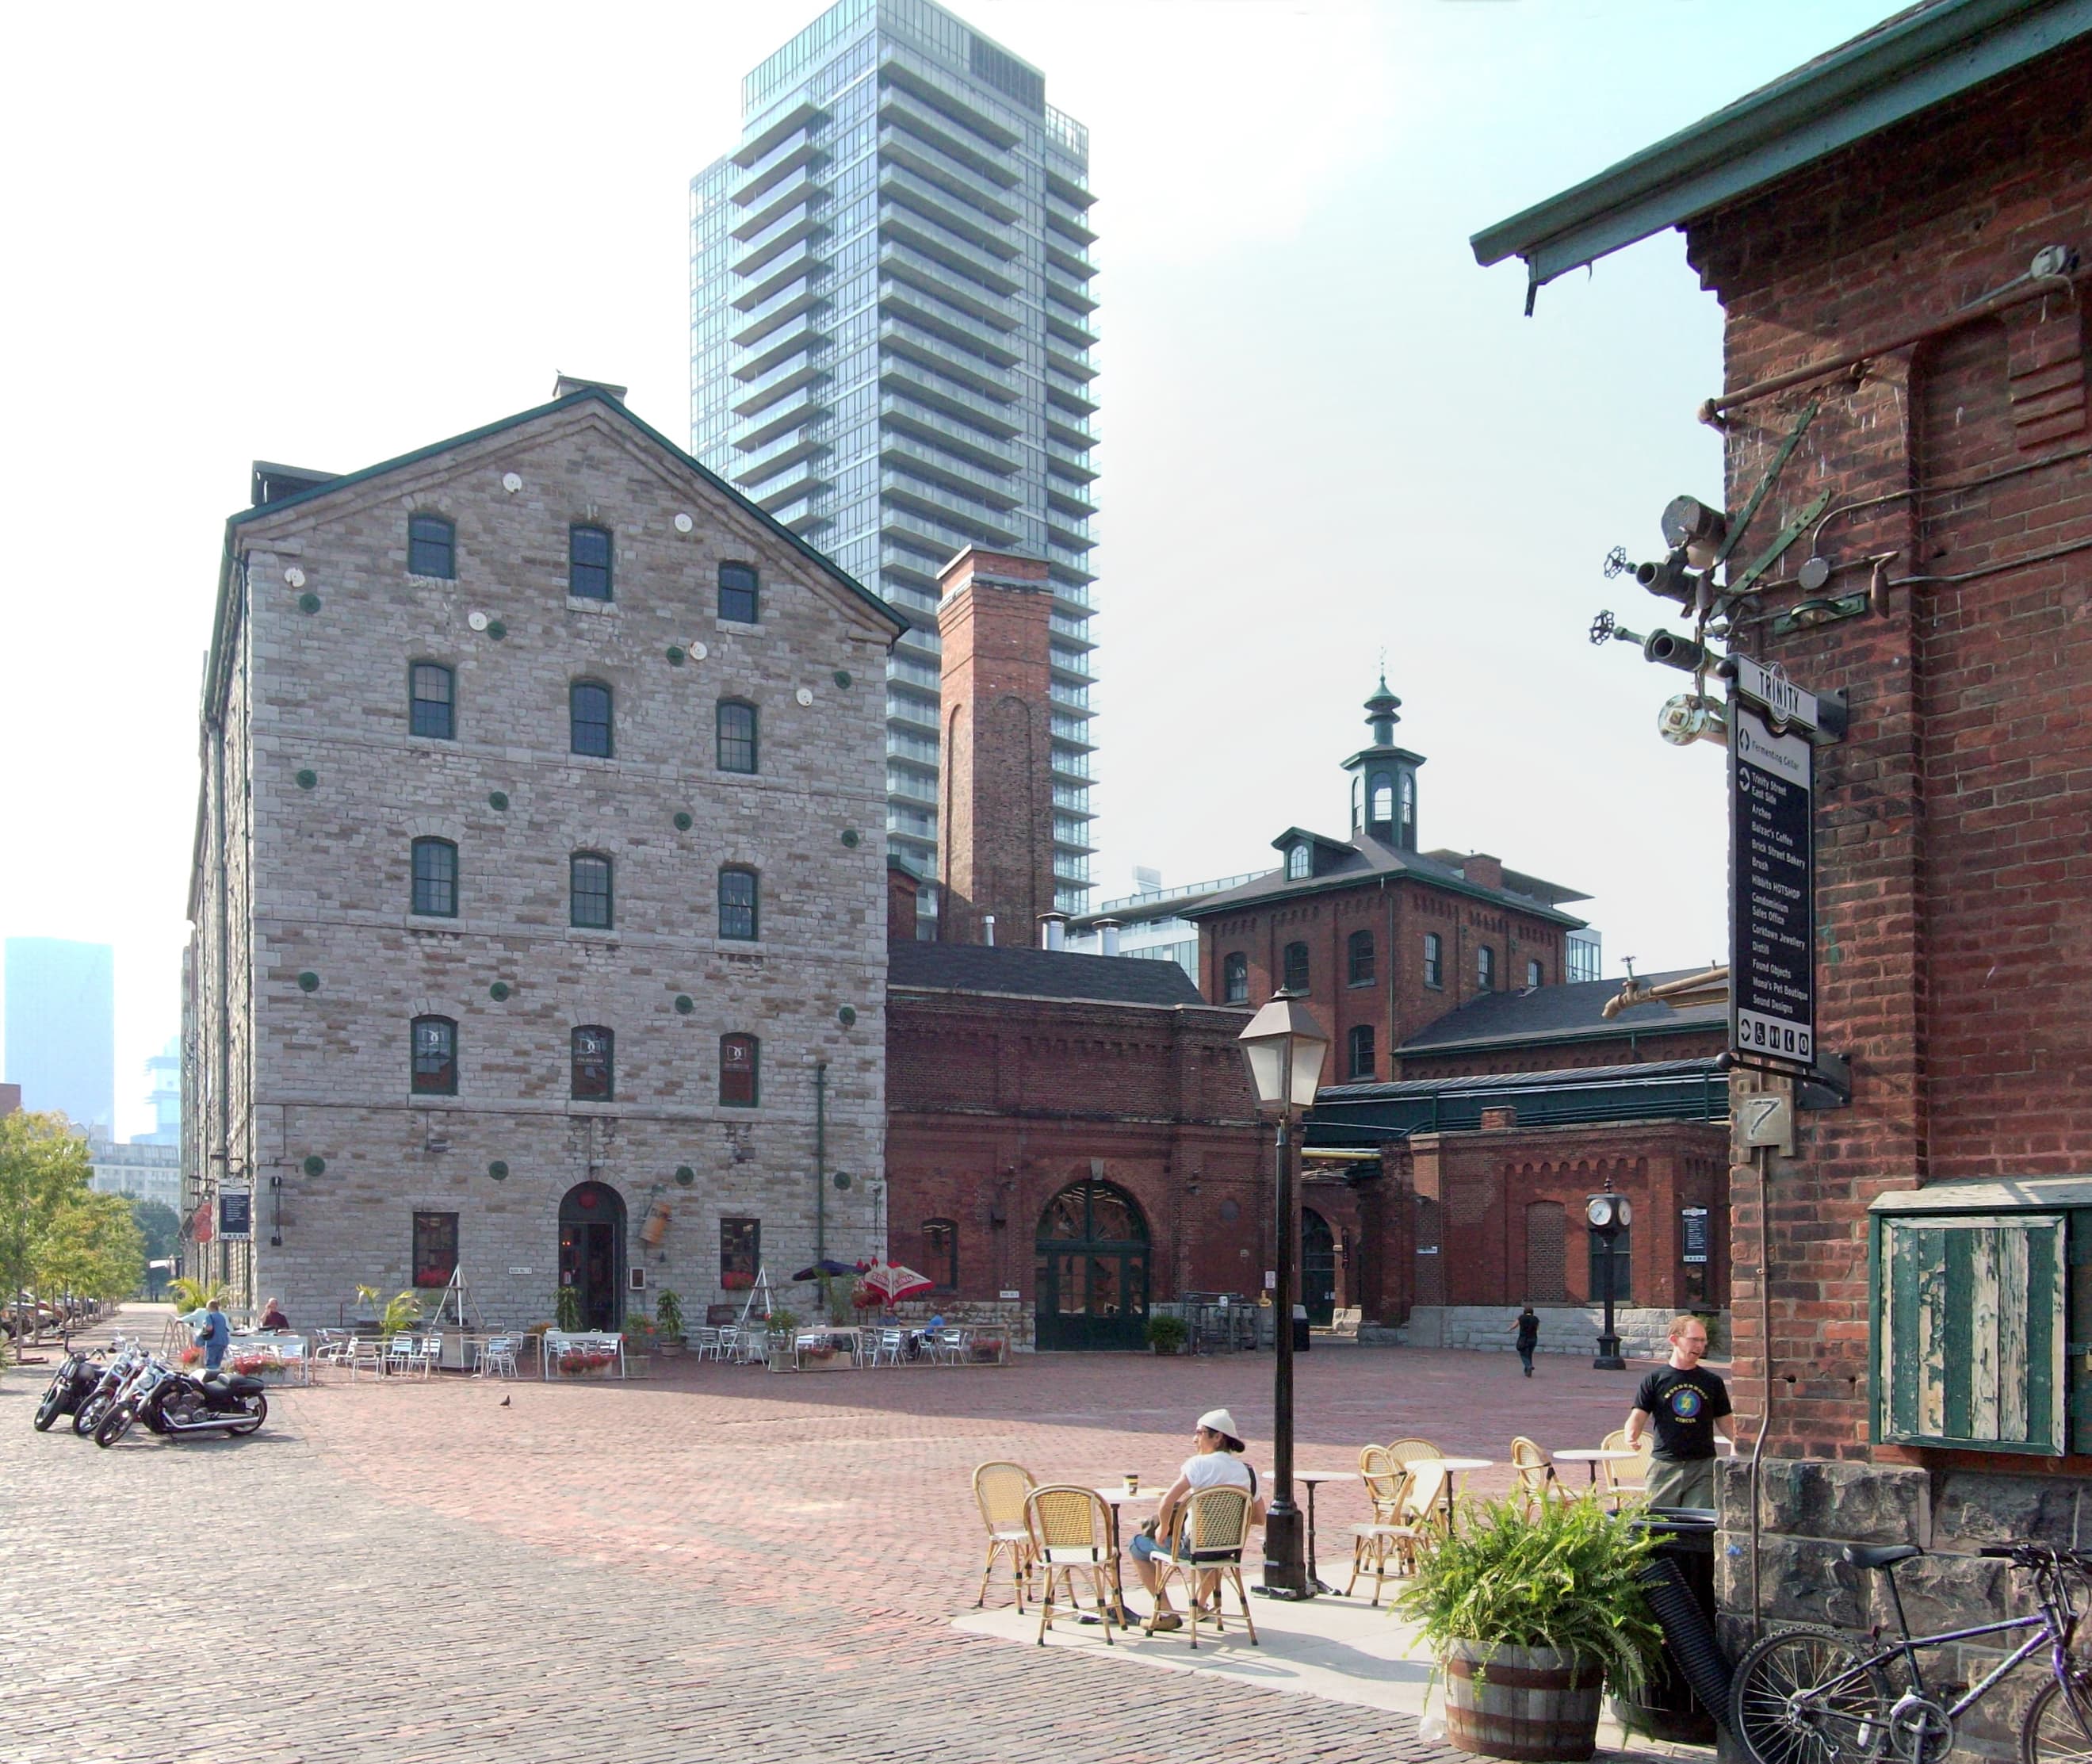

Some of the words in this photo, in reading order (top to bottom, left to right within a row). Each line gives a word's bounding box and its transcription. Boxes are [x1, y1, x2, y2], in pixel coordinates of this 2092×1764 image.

[1758, 671, 1799, 714] TRINITY
[1752, 740, 1782, 765] Fermenting
[1784, 756, 1800, 770] Cellar
[1751, 772, 1769, 790] Trinity
[1770, 781, 1787, 796] Street
[1752, 821, 1774, 839] Balzac's
[1776, 831, 1793, 847] Coffee
[1752, 838, 1766, 853] Brick
[1768, 845, 1785, 861] Street
[1786, 852, 1805, 870] Bakery
[1752, 856, 1769, 872] Brush
[1752, 892, 1788, 913] Condominium
[1752, 905, 1767, 919] Sales
[1769, 911, 1784, 925] Office
[1780, 933, 1805, 951] Jewellery
[1753, 959, 1769, 972] Found
[1770, 964, 1792, 979] Objects
[1773, 982, 1783, 993] Pet
[1784, 985, 1808, 1001] Boutique
[1753, 994, 1770, 1008] Sound
[1772, 999, 1793, 1014] Designs
[1747, 1097, 1781, 1140] 7
